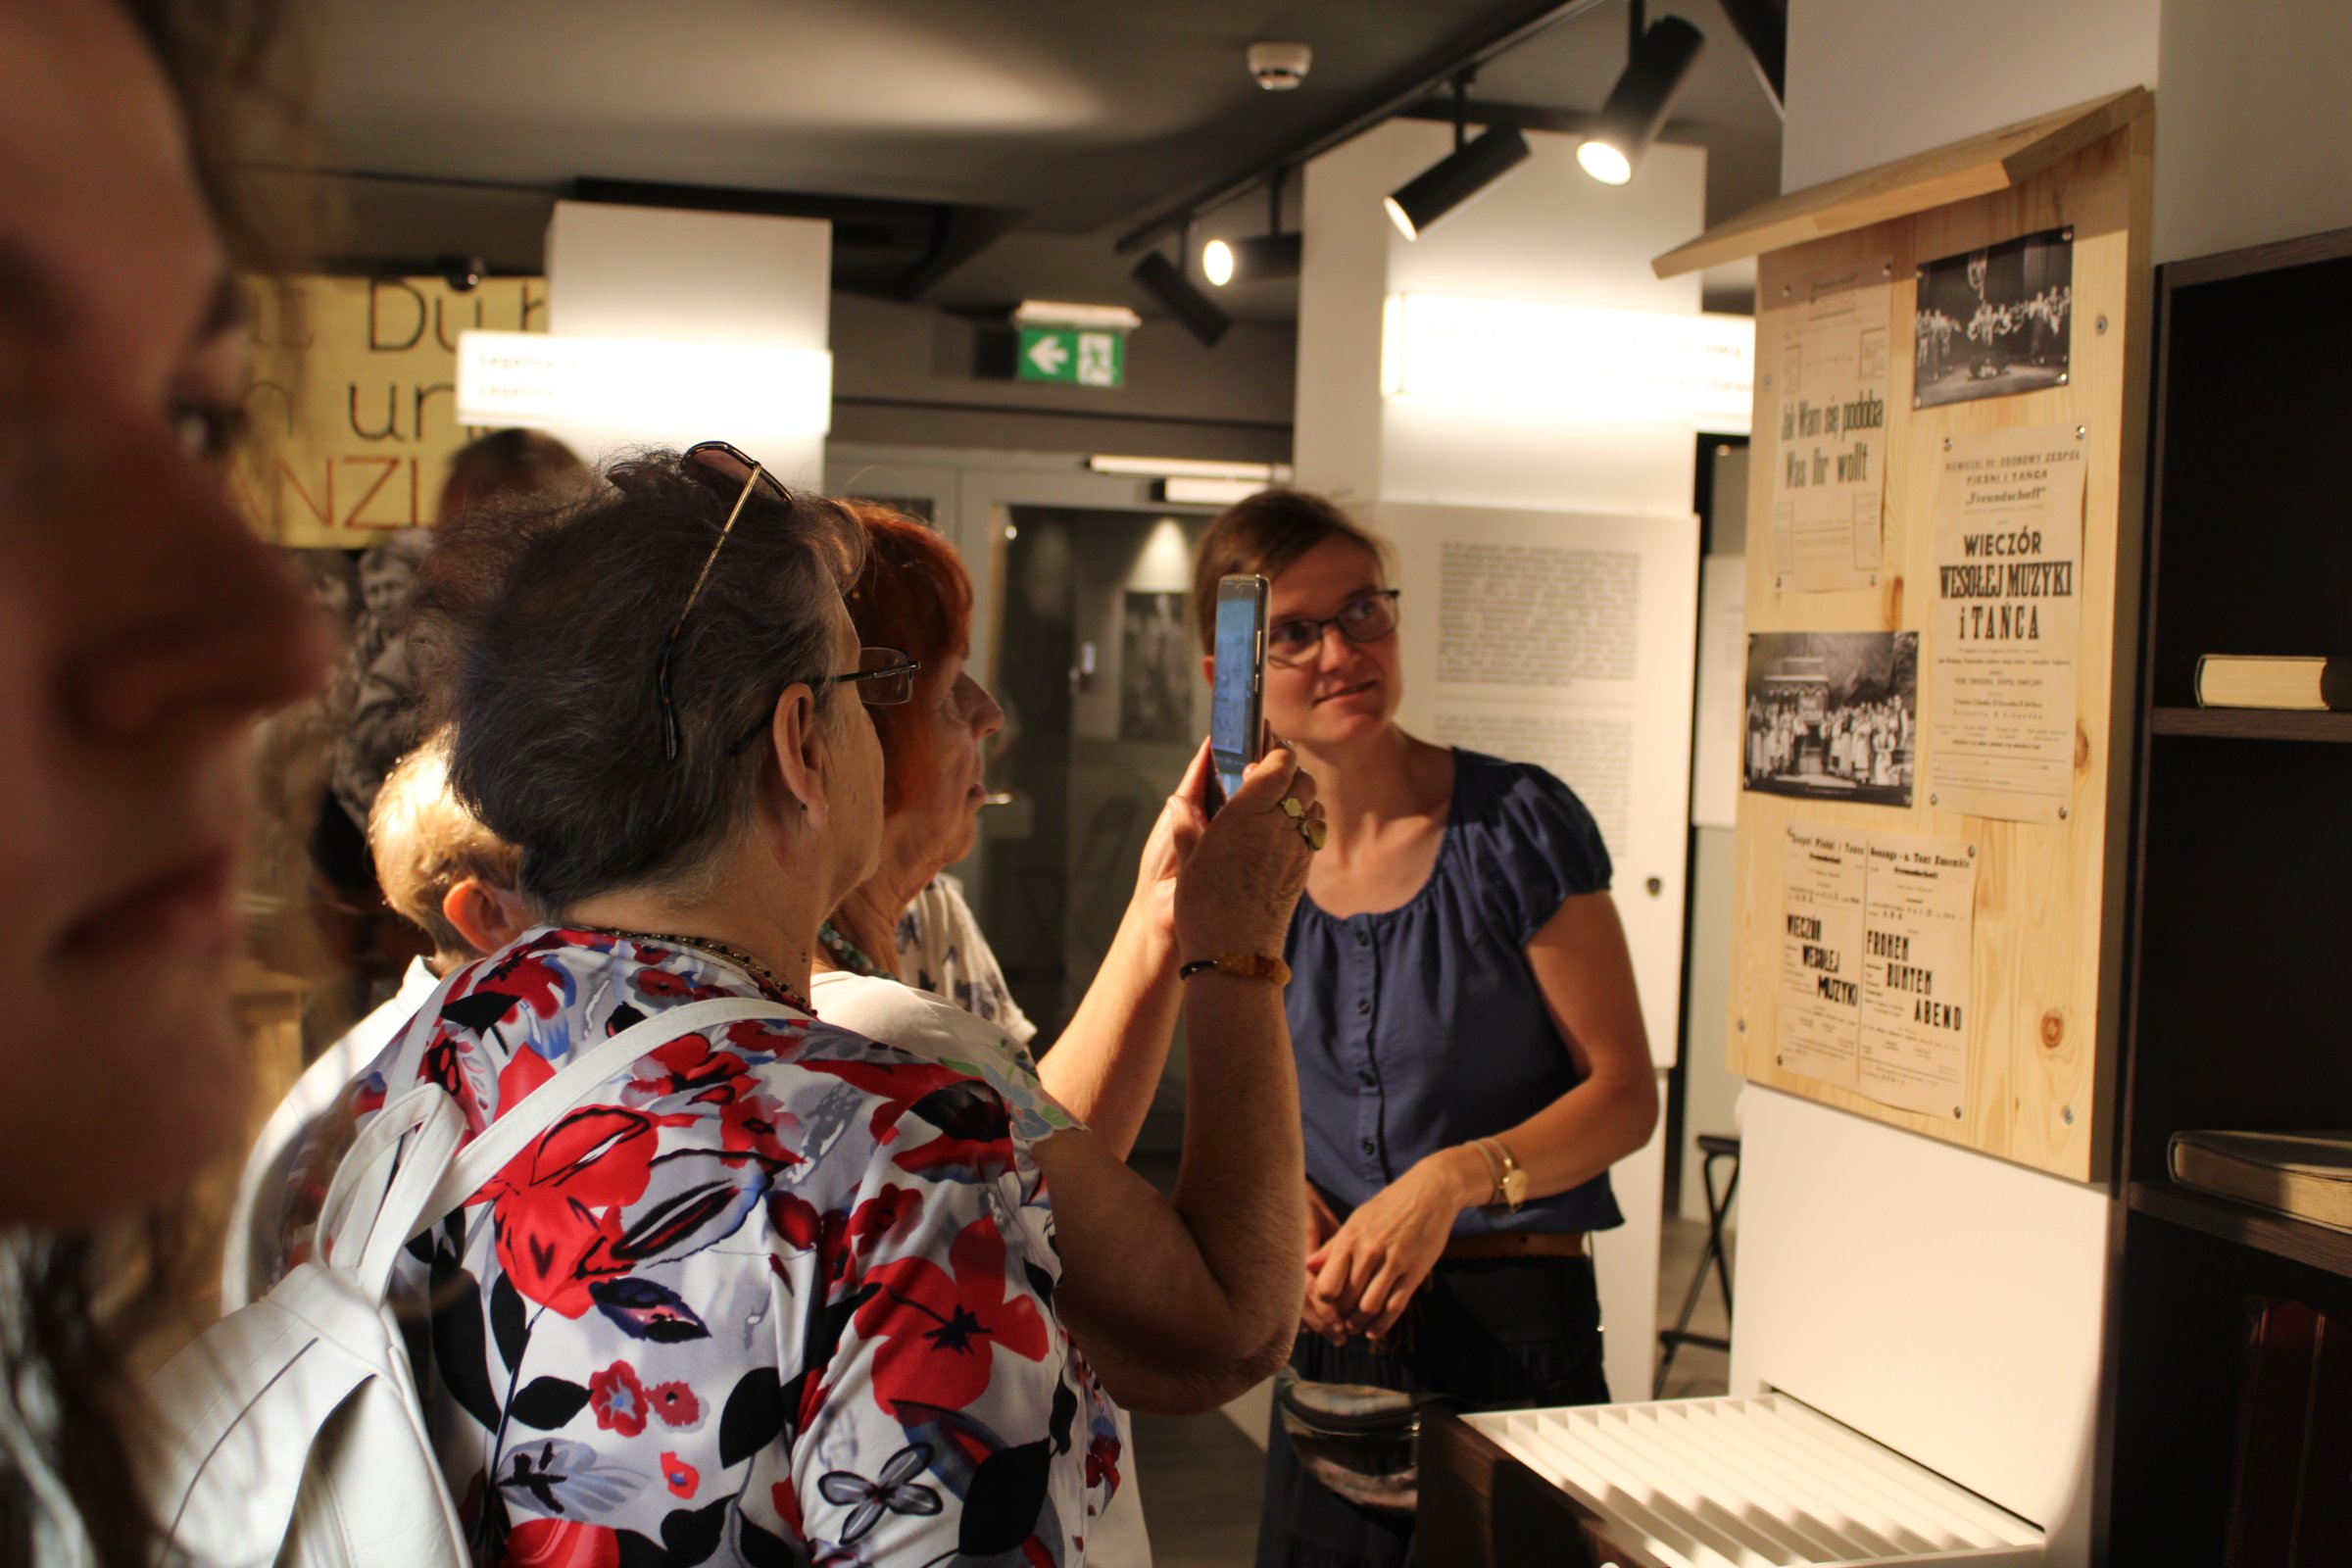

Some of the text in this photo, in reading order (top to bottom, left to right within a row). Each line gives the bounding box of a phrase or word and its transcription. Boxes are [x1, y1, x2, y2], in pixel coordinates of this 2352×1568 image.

[369, 278, 485, 353] Du
[1797, 399, 1822, 438] Wam
[1841, 388, 1884, 443] podoba
[1786, 450, 1807, 489] Was
[1837, 442, 1868, 484] wollt
[1963, 524, 2042, 558] WIECZÓR
[1939, 561, 2073, 600] WESOŁEJ MUZYKI
[1971, 601, 2040, 640] TAŃCA
[1866, 929, 1910, 962] FROHEN
[1817, 974, 1859, 1007] MUZYKI
[1886, 961, 1934, 996] BUNTEN
[1914, 998, 1963, 1032] ABEND
